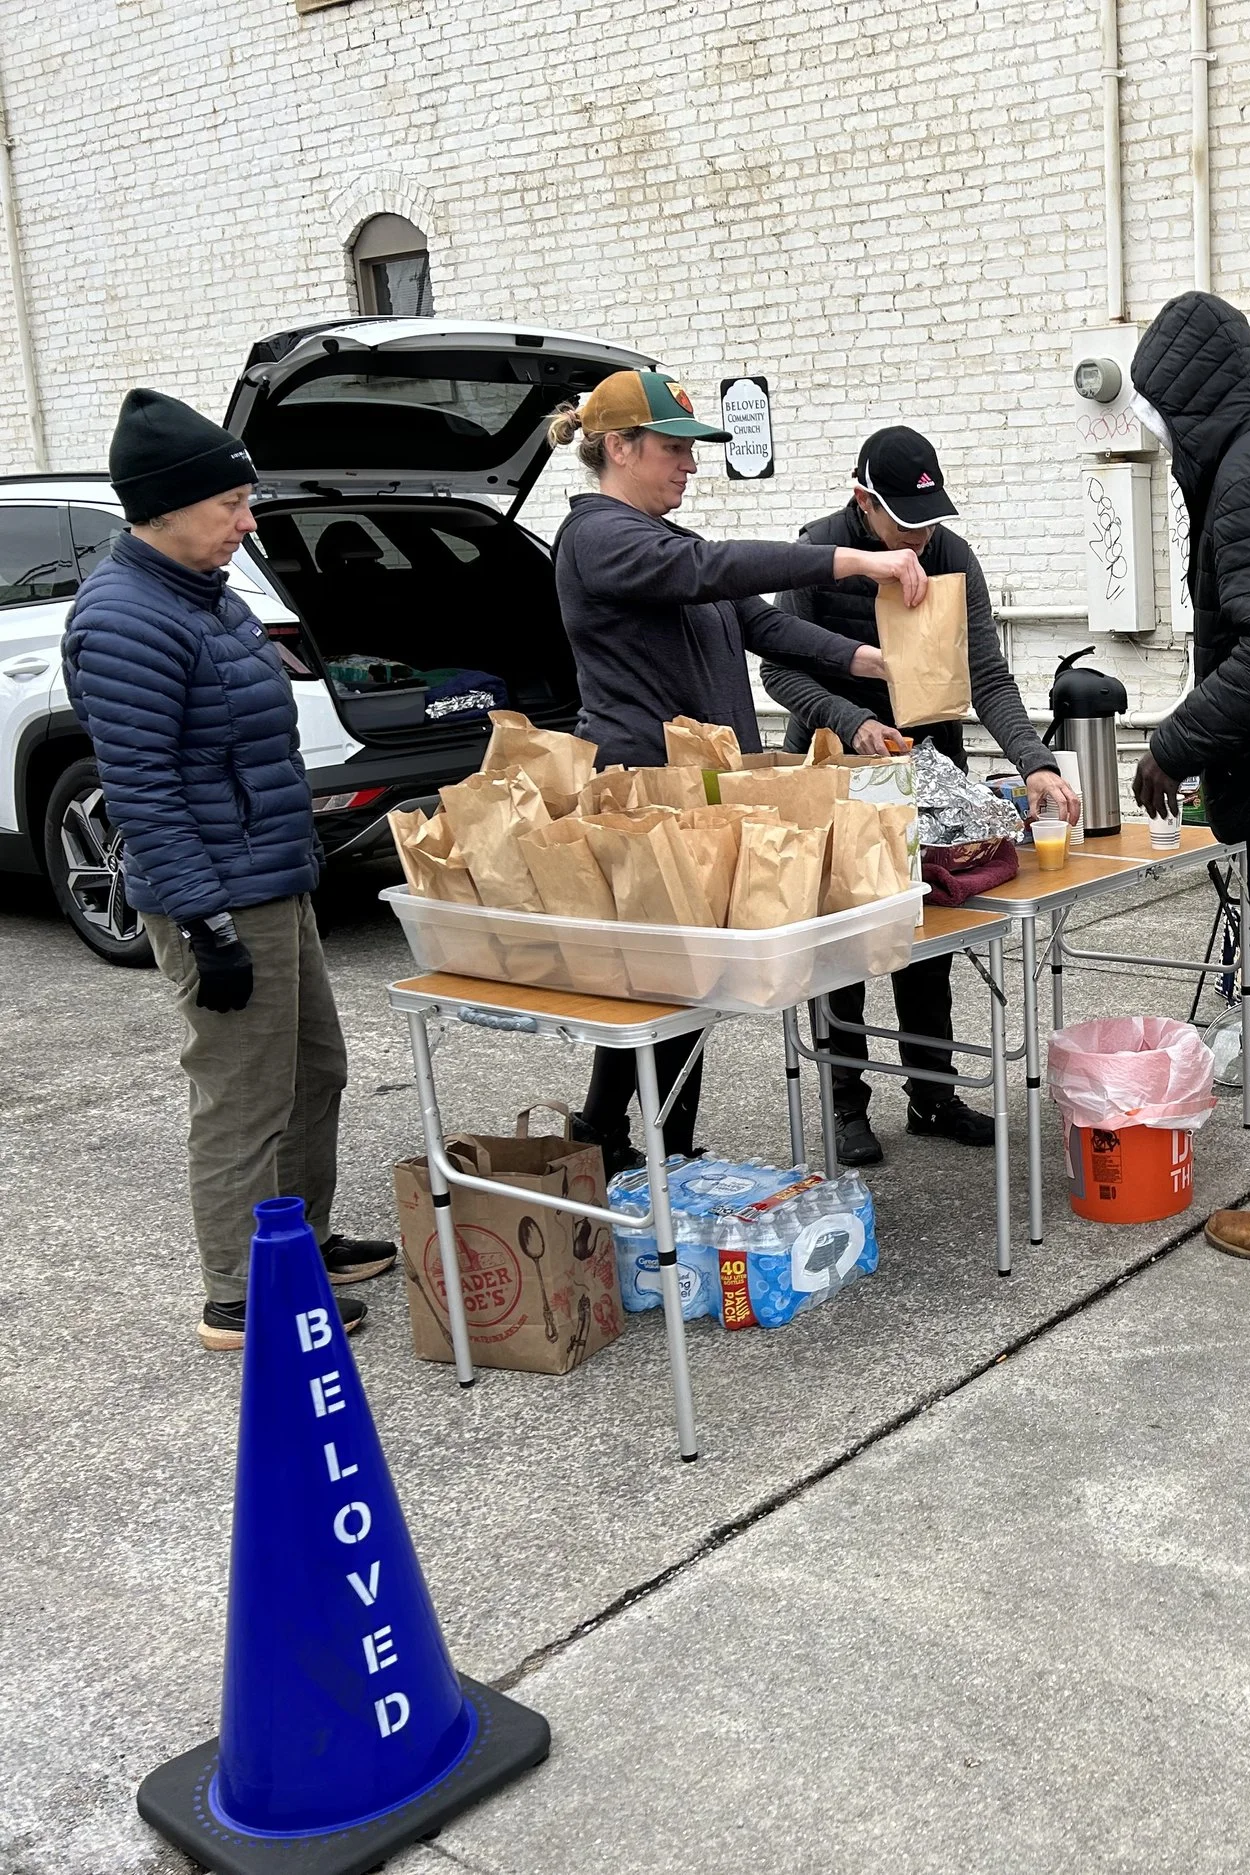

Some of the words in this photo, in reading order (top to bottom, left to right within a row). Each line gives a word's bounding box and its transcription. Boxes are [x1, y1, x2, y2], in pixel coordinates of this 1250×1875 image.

[725, 399, 766, 412] BELOVED
[727, 412, 765, 423] COMMUNITY
[734, 425, 761, 435] CHURCH
[729, 441, 769, 458] Parking
[721, 1260, 746, 1275] 40
[437, 1267, 513, 1297] TADER
[463, 1289, 506, 1313] OE'S
[724, 1291, 737, 1323] PACK
[734, 1287, 751, 1322] VALUE
[296, 1308, 410, 1739] BELOVED
